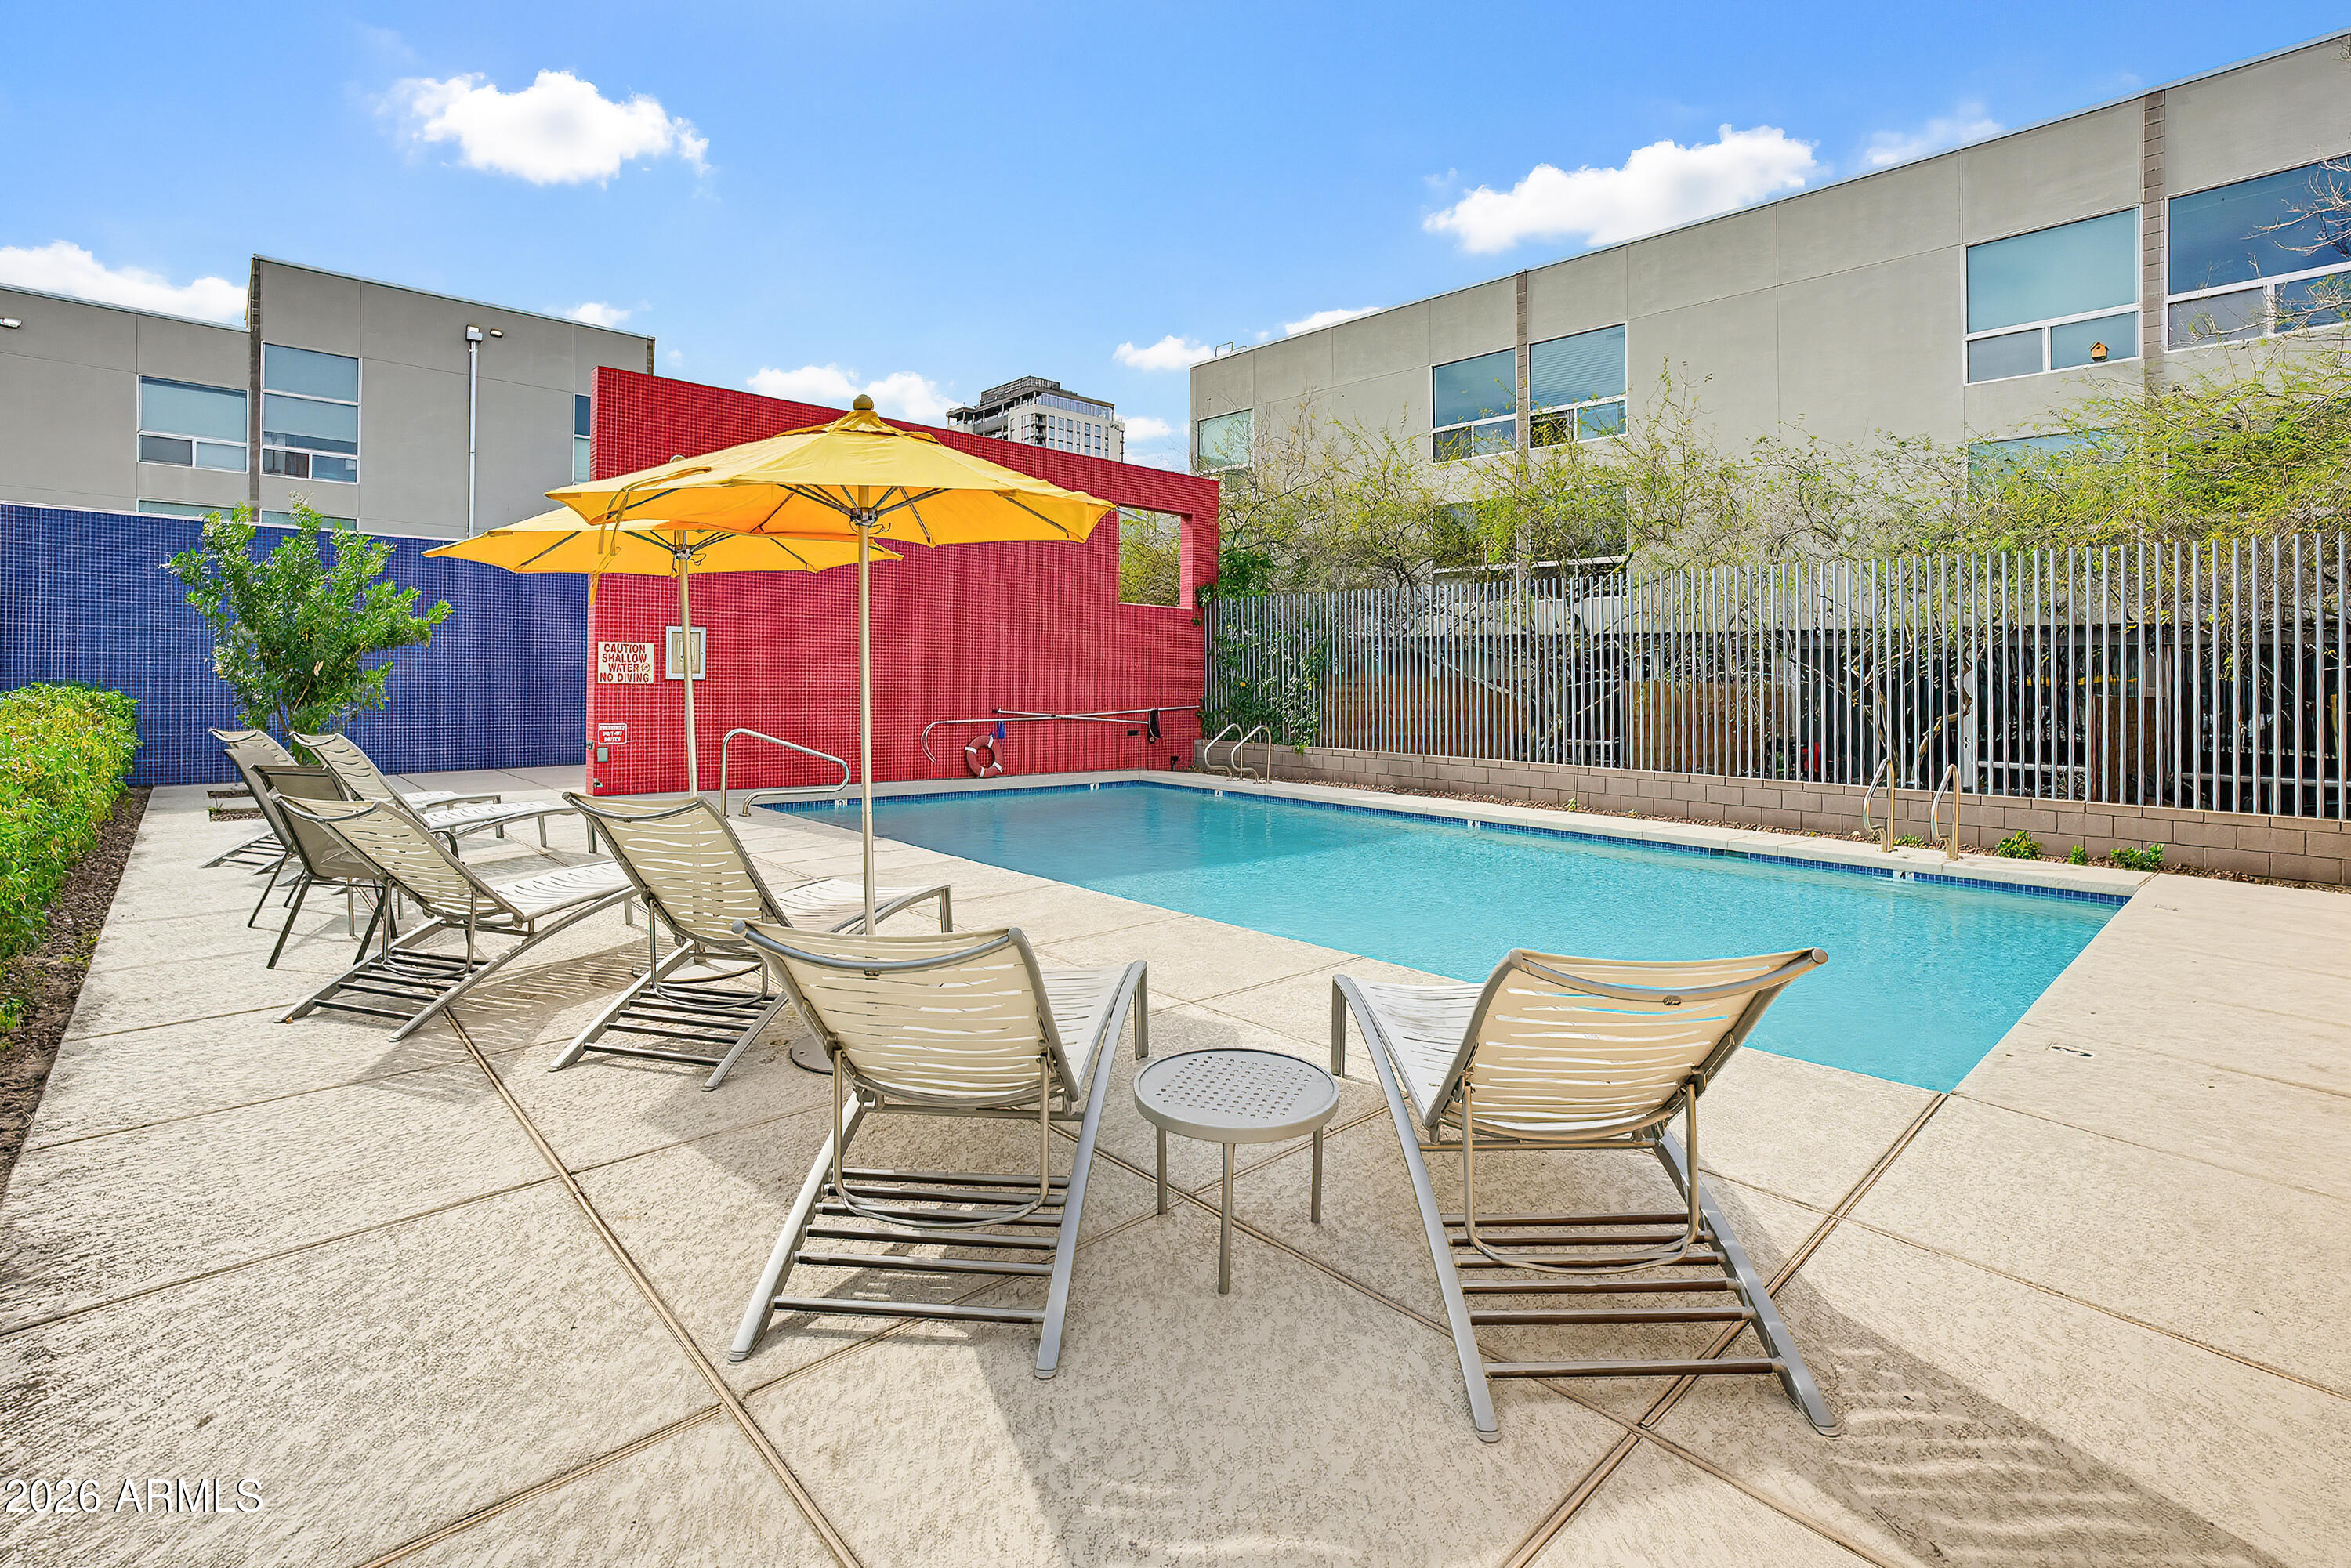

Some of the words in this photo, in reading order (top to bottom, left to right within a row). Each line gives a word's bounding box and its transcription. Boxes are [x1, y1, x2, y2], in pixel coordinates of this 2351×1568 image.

[603, 643, 646, 654] CAUTION
[602, 654, 647, 663] SHALLOW
[608, 663, 639, 672] WATER
[600, 672, 614, 682] NO
[617, 672, 649, 683] DIVING
